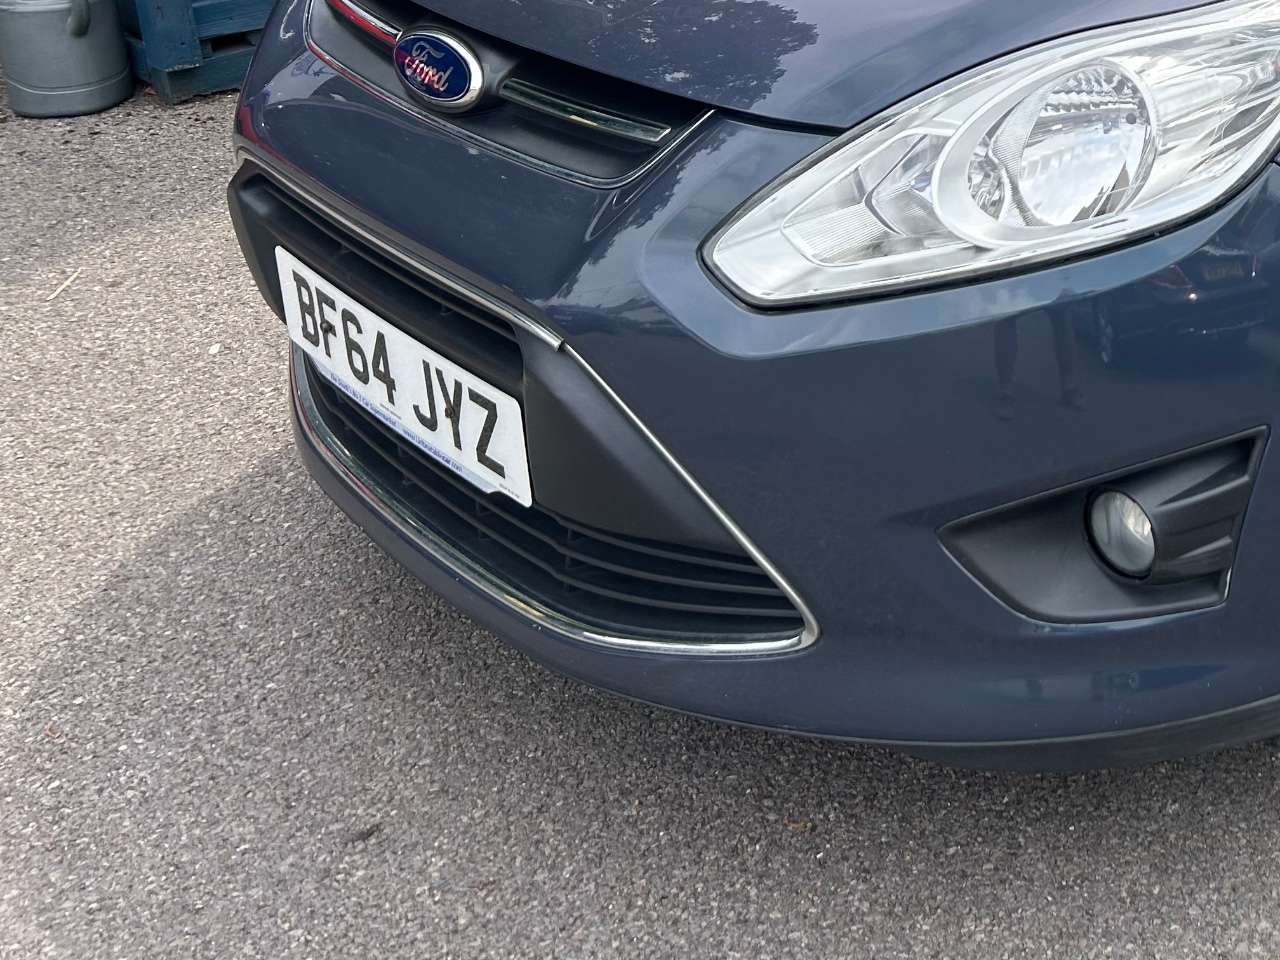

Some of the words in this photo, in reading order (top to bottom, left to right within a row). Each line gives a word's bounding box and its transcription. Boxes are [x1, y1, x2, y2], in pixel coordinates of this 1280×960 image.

[404, 41, 454, 92] Ford
[292, 269, 397, 407] BF64
[412, 359, 506, 480] JYZ
